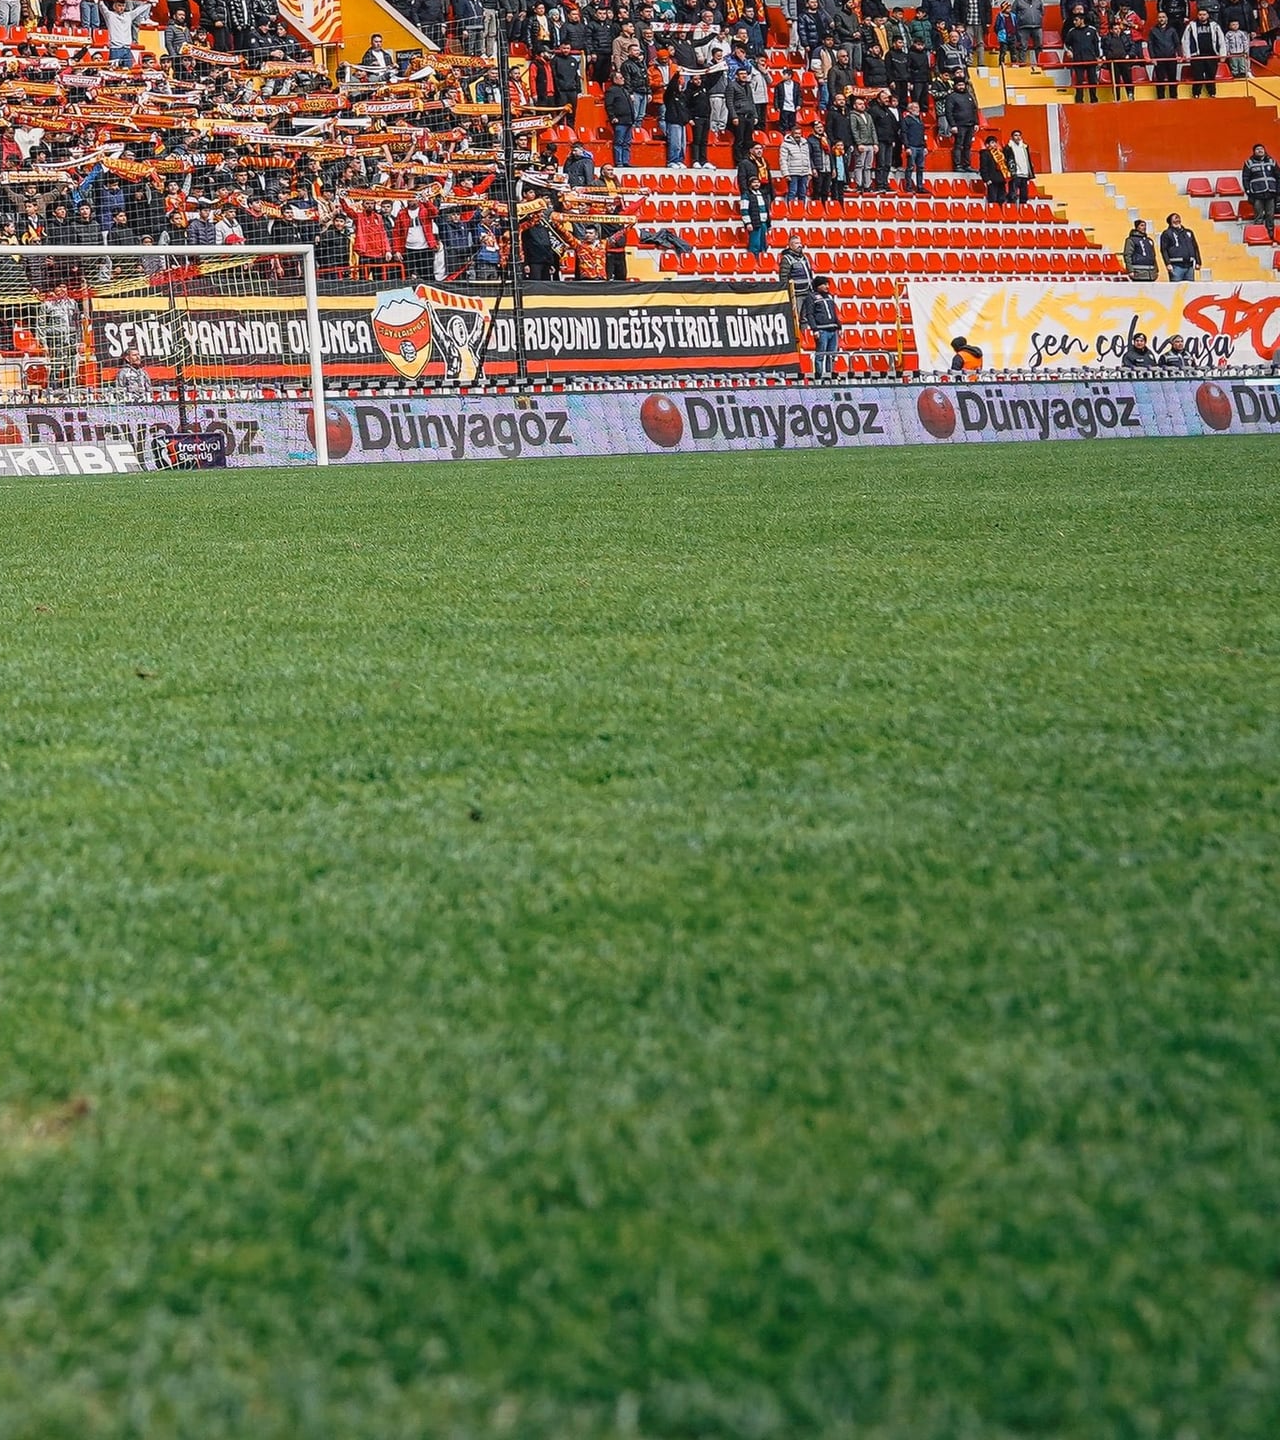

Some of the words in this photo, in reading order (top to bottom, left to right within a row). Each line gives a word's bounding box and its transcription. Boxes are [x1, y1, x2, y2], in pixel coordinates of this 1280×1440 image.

[104, 312, 174, 358] SENİN
[185, 313, 281, 355] YANINDA
[607, 305, 719, 350] DEĞİŞTİRDİ
[727, 305, 789, 347] DÜNYA
[359, 403, 575, 458] Dünyagöz
[689, 393, 883, 448] Dünyagöz
[959, 386, 1140, 440] Dünyagöz
[176, 438, 222, 455] trendyol
